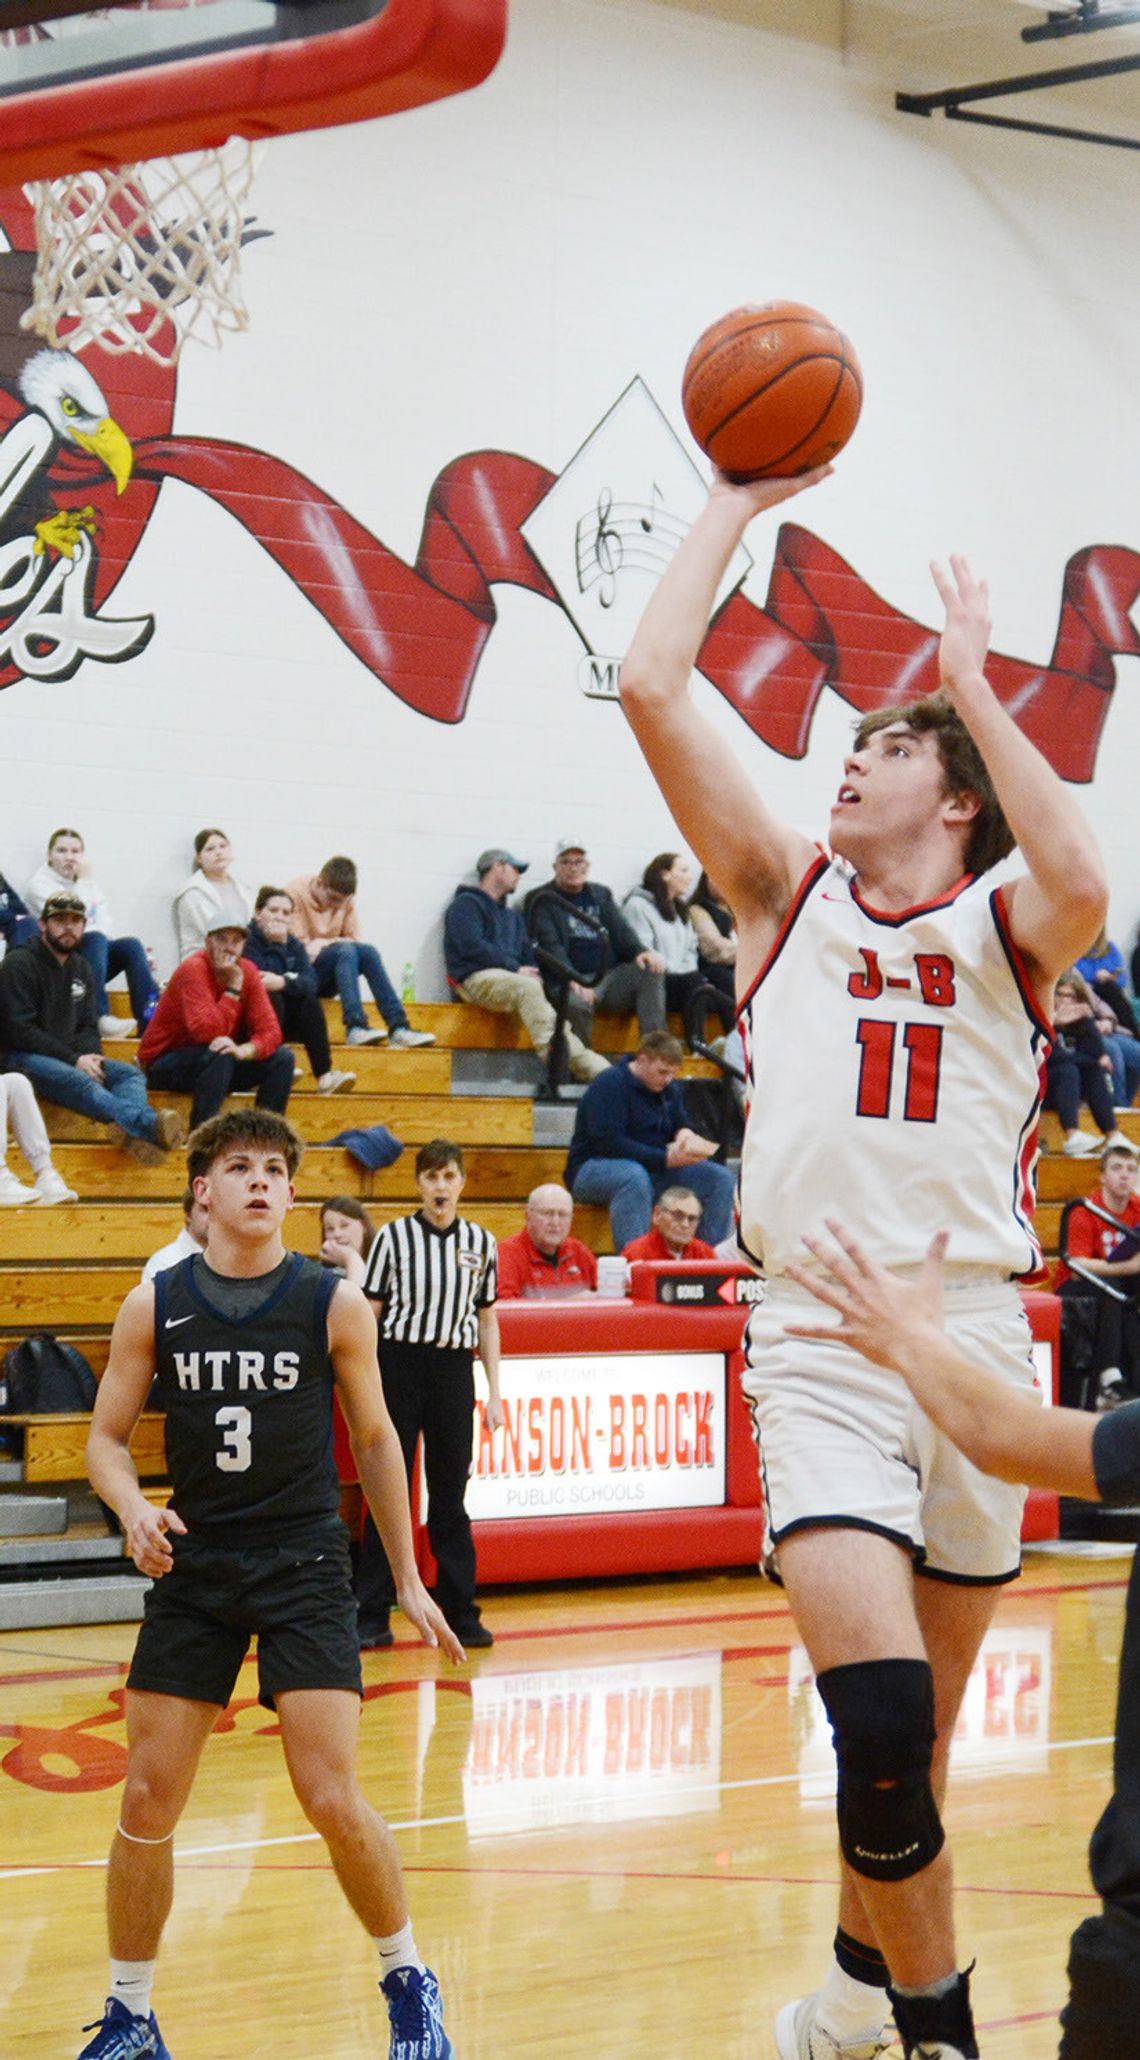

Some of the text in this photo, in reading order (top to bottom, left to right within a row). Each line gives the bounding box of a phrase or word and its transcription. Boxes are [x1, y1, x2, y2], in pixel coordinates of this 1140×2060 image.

[589, 662, 622, 691] M
[847, 947, 956, 1007] J-B
[856, 1018, 944, 1123] 11
[736, 1279, 768, 1302] POS
[172, 1351, 300, 1391] HTRS
[215, 1406, 252, 1472] 3
[472, 1390, 714, 1479] HNSON-BROCK
[507, 1481, 646, 1507] PUBLIC SCHOOLS
